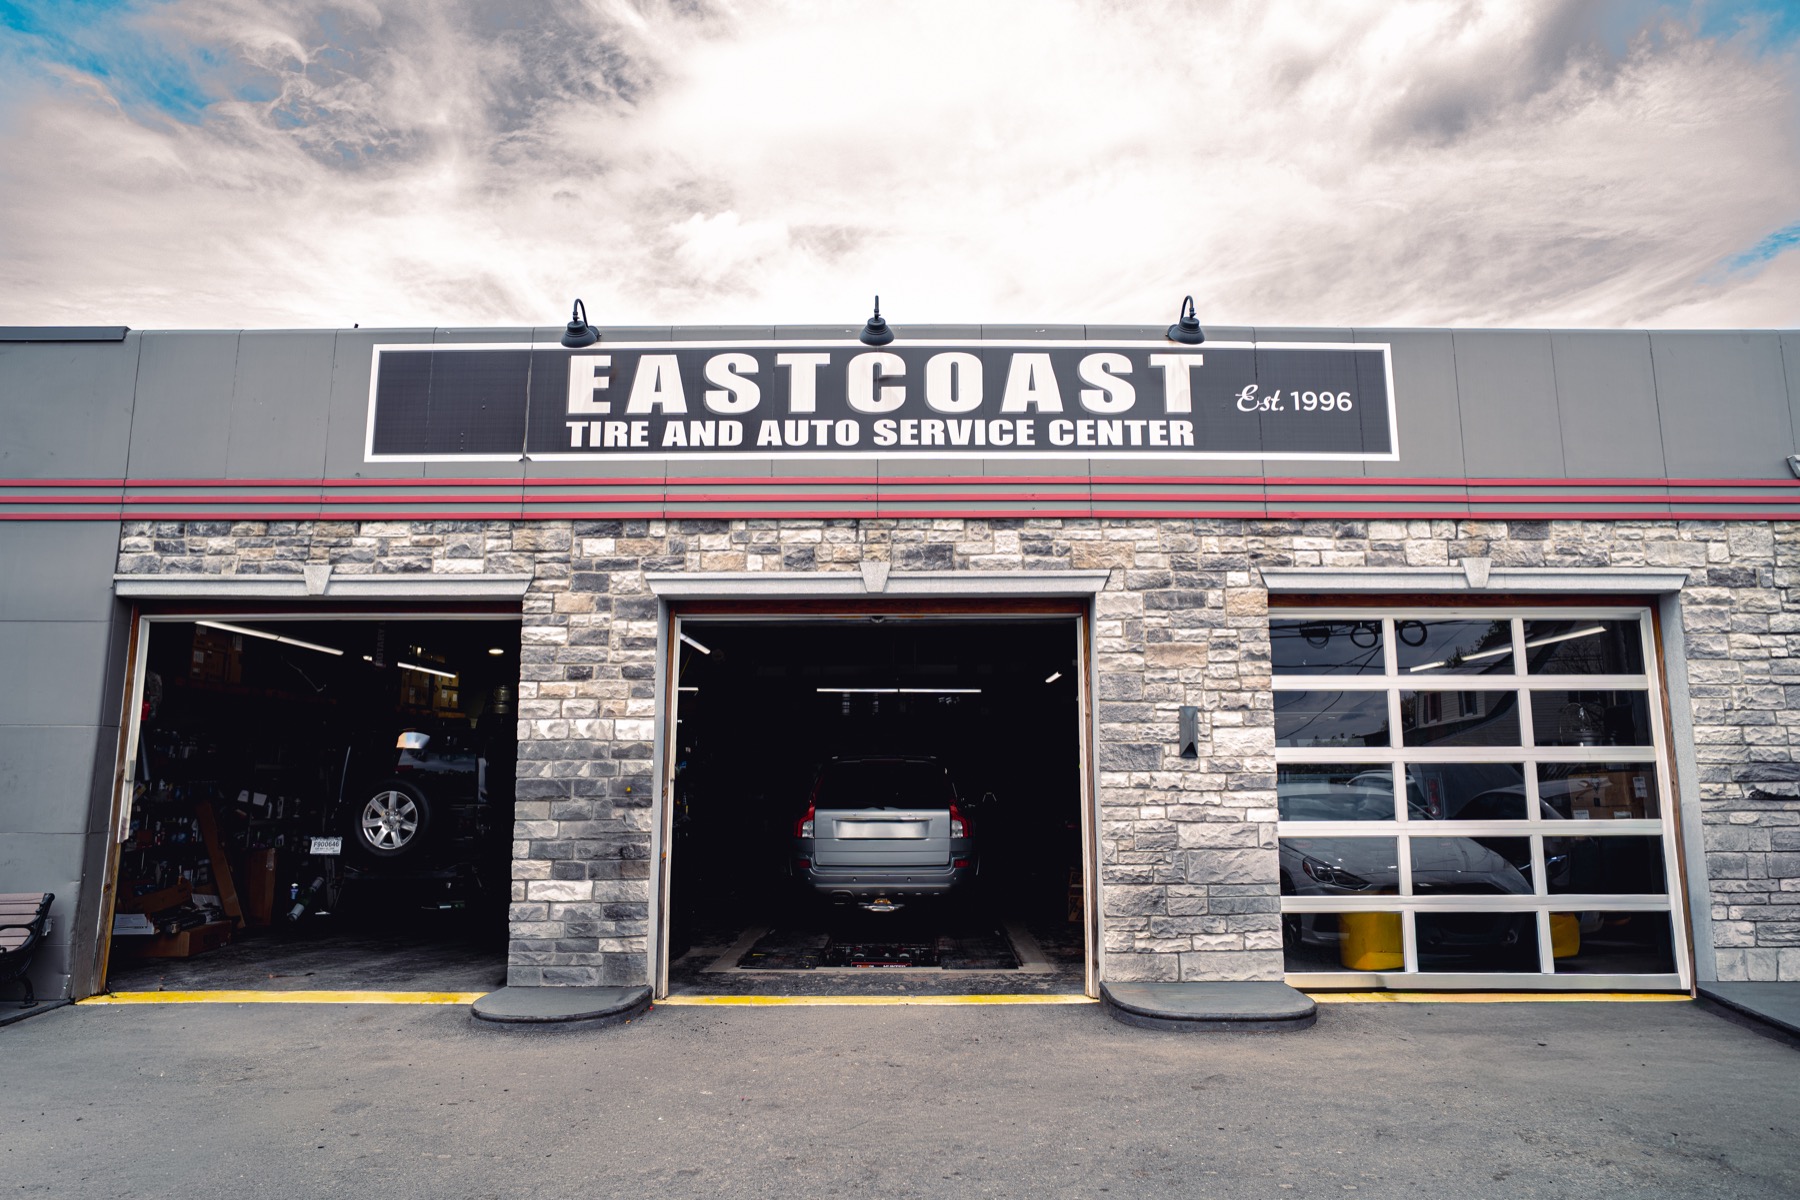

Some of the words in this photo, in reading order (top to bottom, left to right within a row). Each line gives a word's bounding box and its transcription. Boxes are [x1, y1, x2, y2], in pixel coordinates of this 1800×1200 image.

[566, 352, 1203, 414] EASTCOAST
[1235, 384, 1285, 412] Est.
[1290, 391, 1353, 412] 1996
[566, 419, 649, 447] TIRE
[661, 419, 744, 447] AND
[756, 419, 861, 447] AUTO
[873, 418, 1035, 447] SERVICE
[1048, 418, 1195, 447] CENTER
